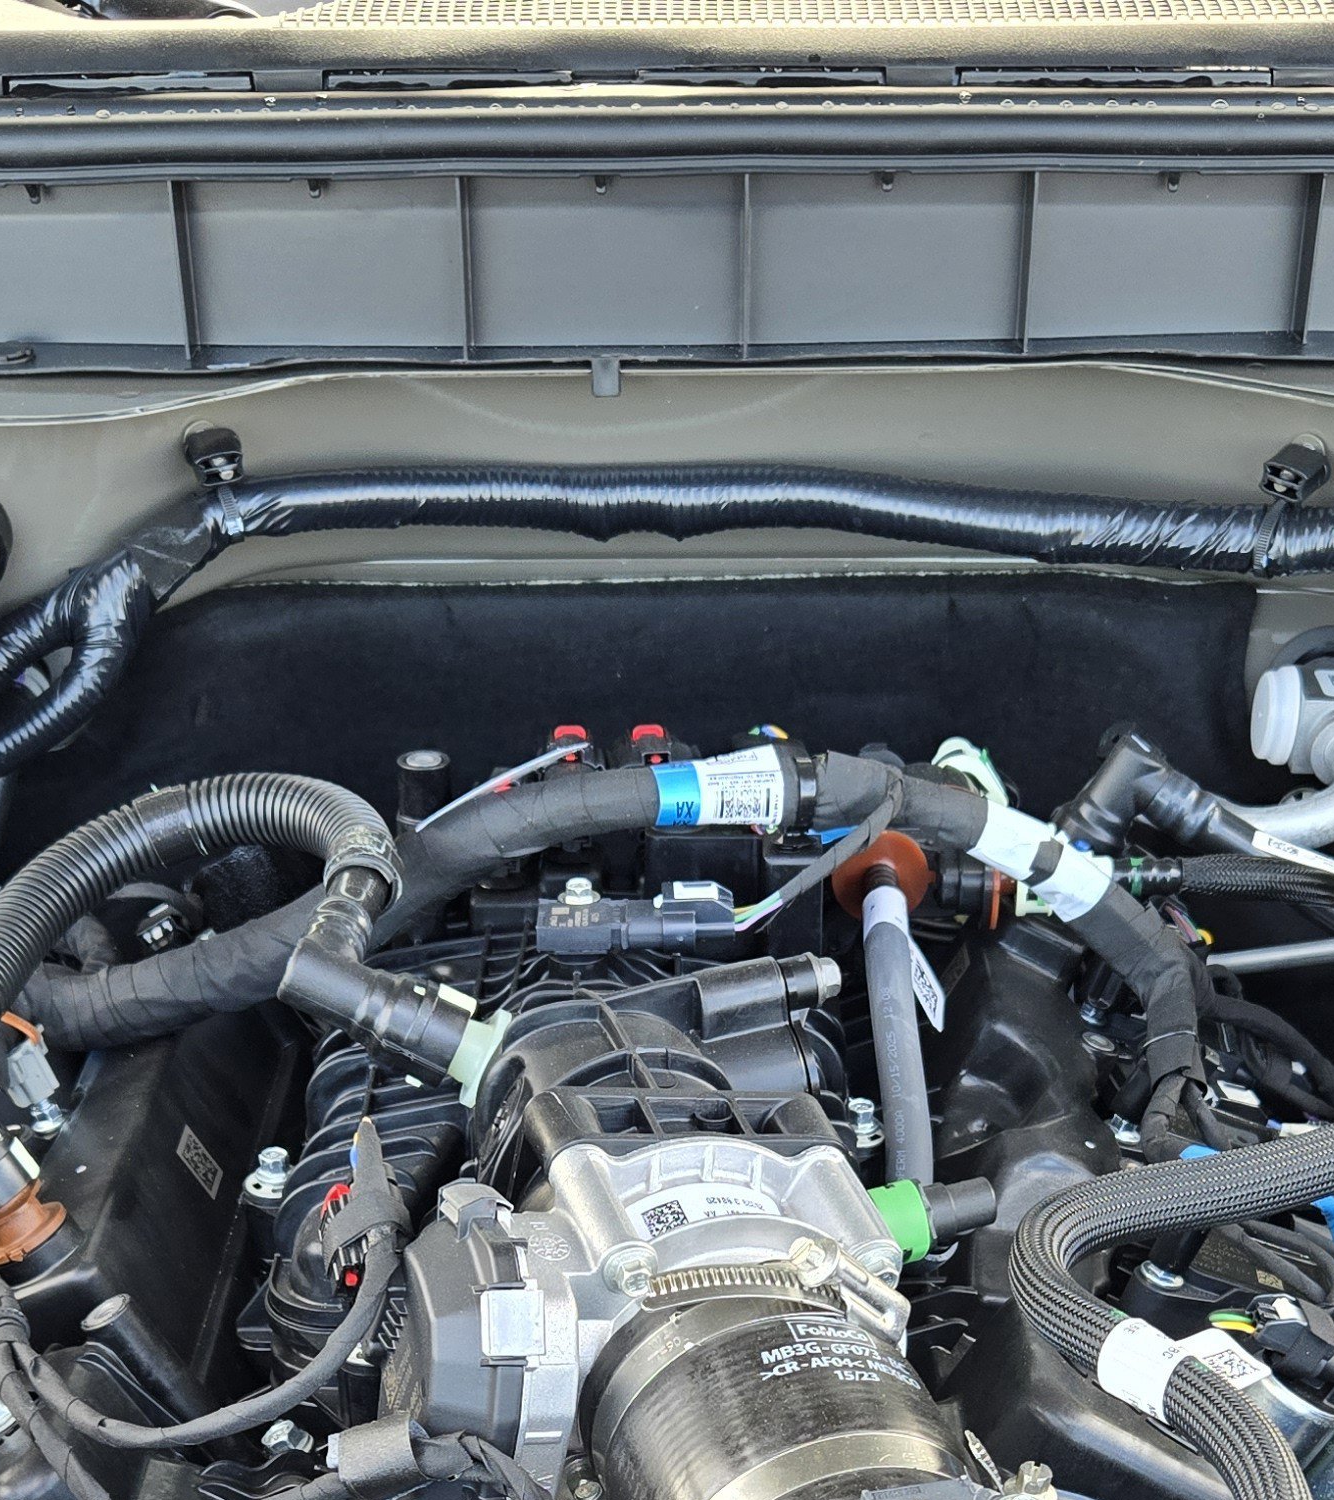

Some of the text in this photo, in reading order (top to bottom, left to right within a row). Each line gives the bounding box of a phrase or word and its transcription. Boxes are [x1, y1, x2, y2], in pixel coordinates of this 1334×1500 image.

[676, 801, 694, 818] XA
[796, 1323, 867, 1342] FoMoCo
[833, 1370, 881, 1382] 15/23
[867, 1359, 921, 1390] MEXICO
